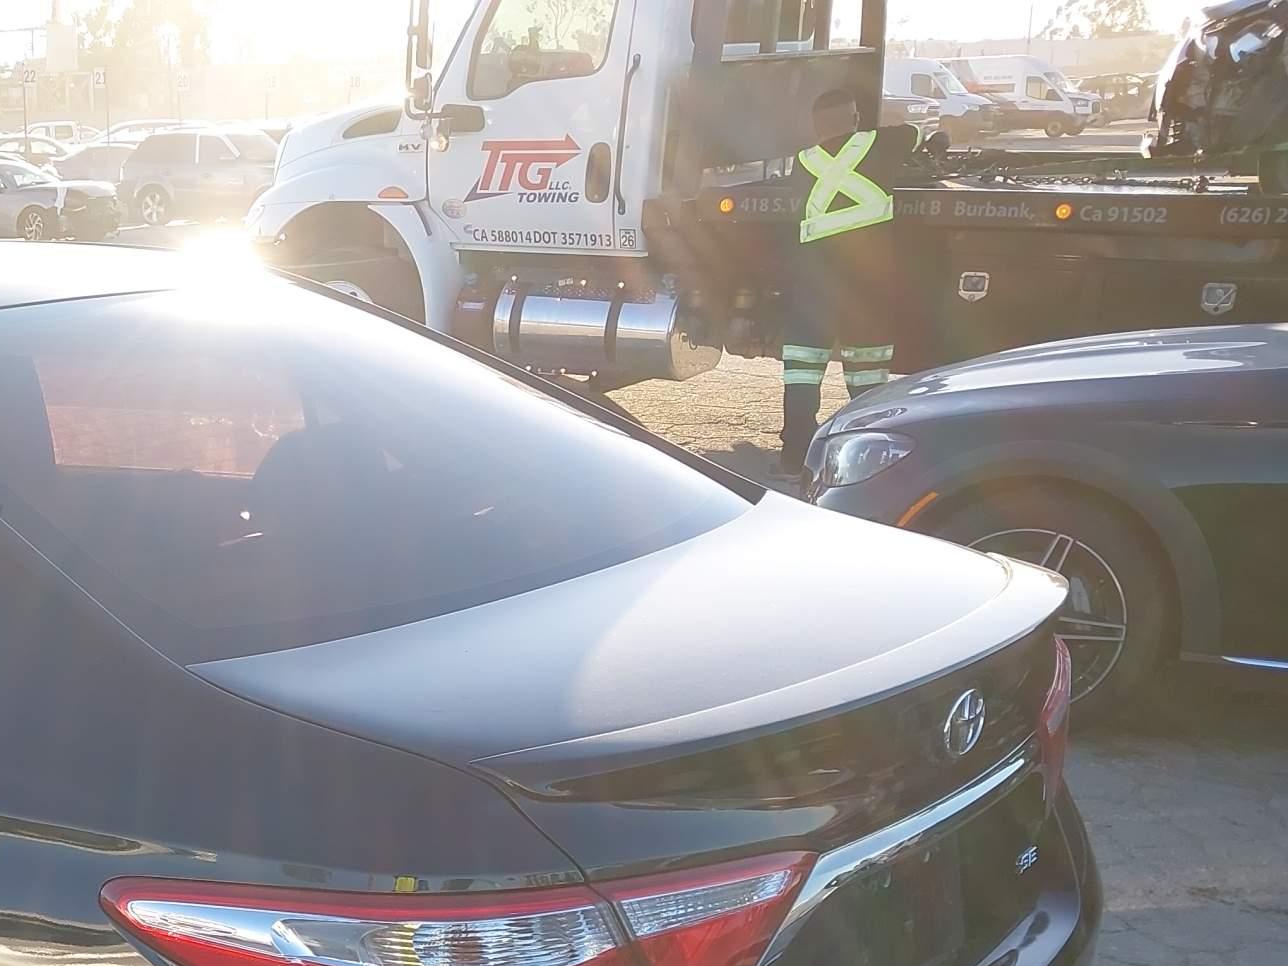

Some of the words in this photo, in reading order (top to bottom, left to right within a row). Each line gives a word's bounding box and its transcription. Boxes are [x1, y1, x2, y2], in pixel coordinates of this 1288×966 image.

[23, 70, 36, 84] 22
[95, 71, 106, 85] 21
[517, 192, 580, 203] TOWING
[740, 197, 769, 212] 418
[954, 201, 1035, 220] Burbank,
[1079, 207, 1104, 222] Ca
[1107, 207, 1168, 223] 91502
[1219, 207, 1272, 224] (626)
[472, 228, 489, 242] CA
[491, 230, 533, 244] 588014
[533, 231, 558, 246] DOT
[560, 233, 613, 248] 3571913
[621, 234, 635, 247] 26
[1015, 845, 1039, 874] SE
